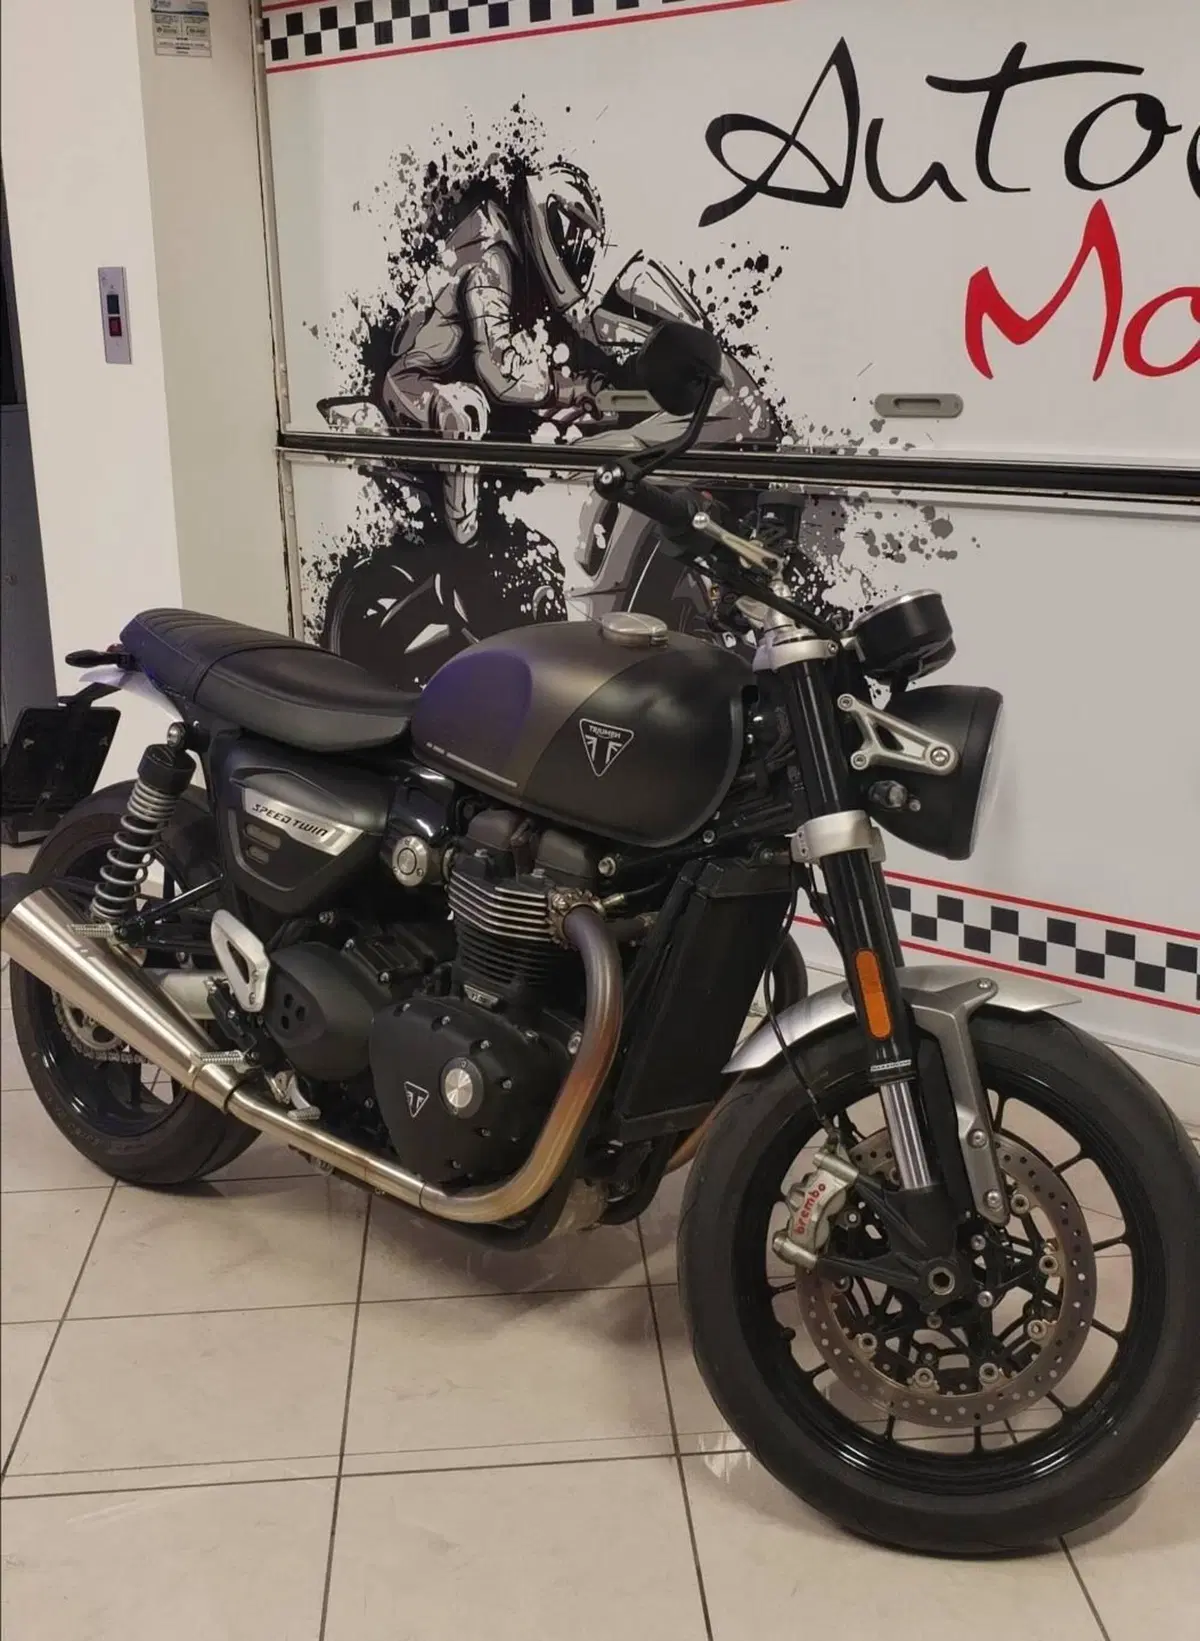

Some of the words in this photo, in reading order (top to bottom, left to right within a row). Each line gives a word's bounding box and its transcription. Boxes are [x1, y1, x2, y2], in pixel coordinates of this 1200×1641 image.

[698, 36, 1200, 227] Auto
[589, 725, 621, 739] TRIUMPH
[252, 803, 292, 824] SPEED
[292, 819, 329, 837] TWIN
[793, 1183, 826, 1234] brembo
